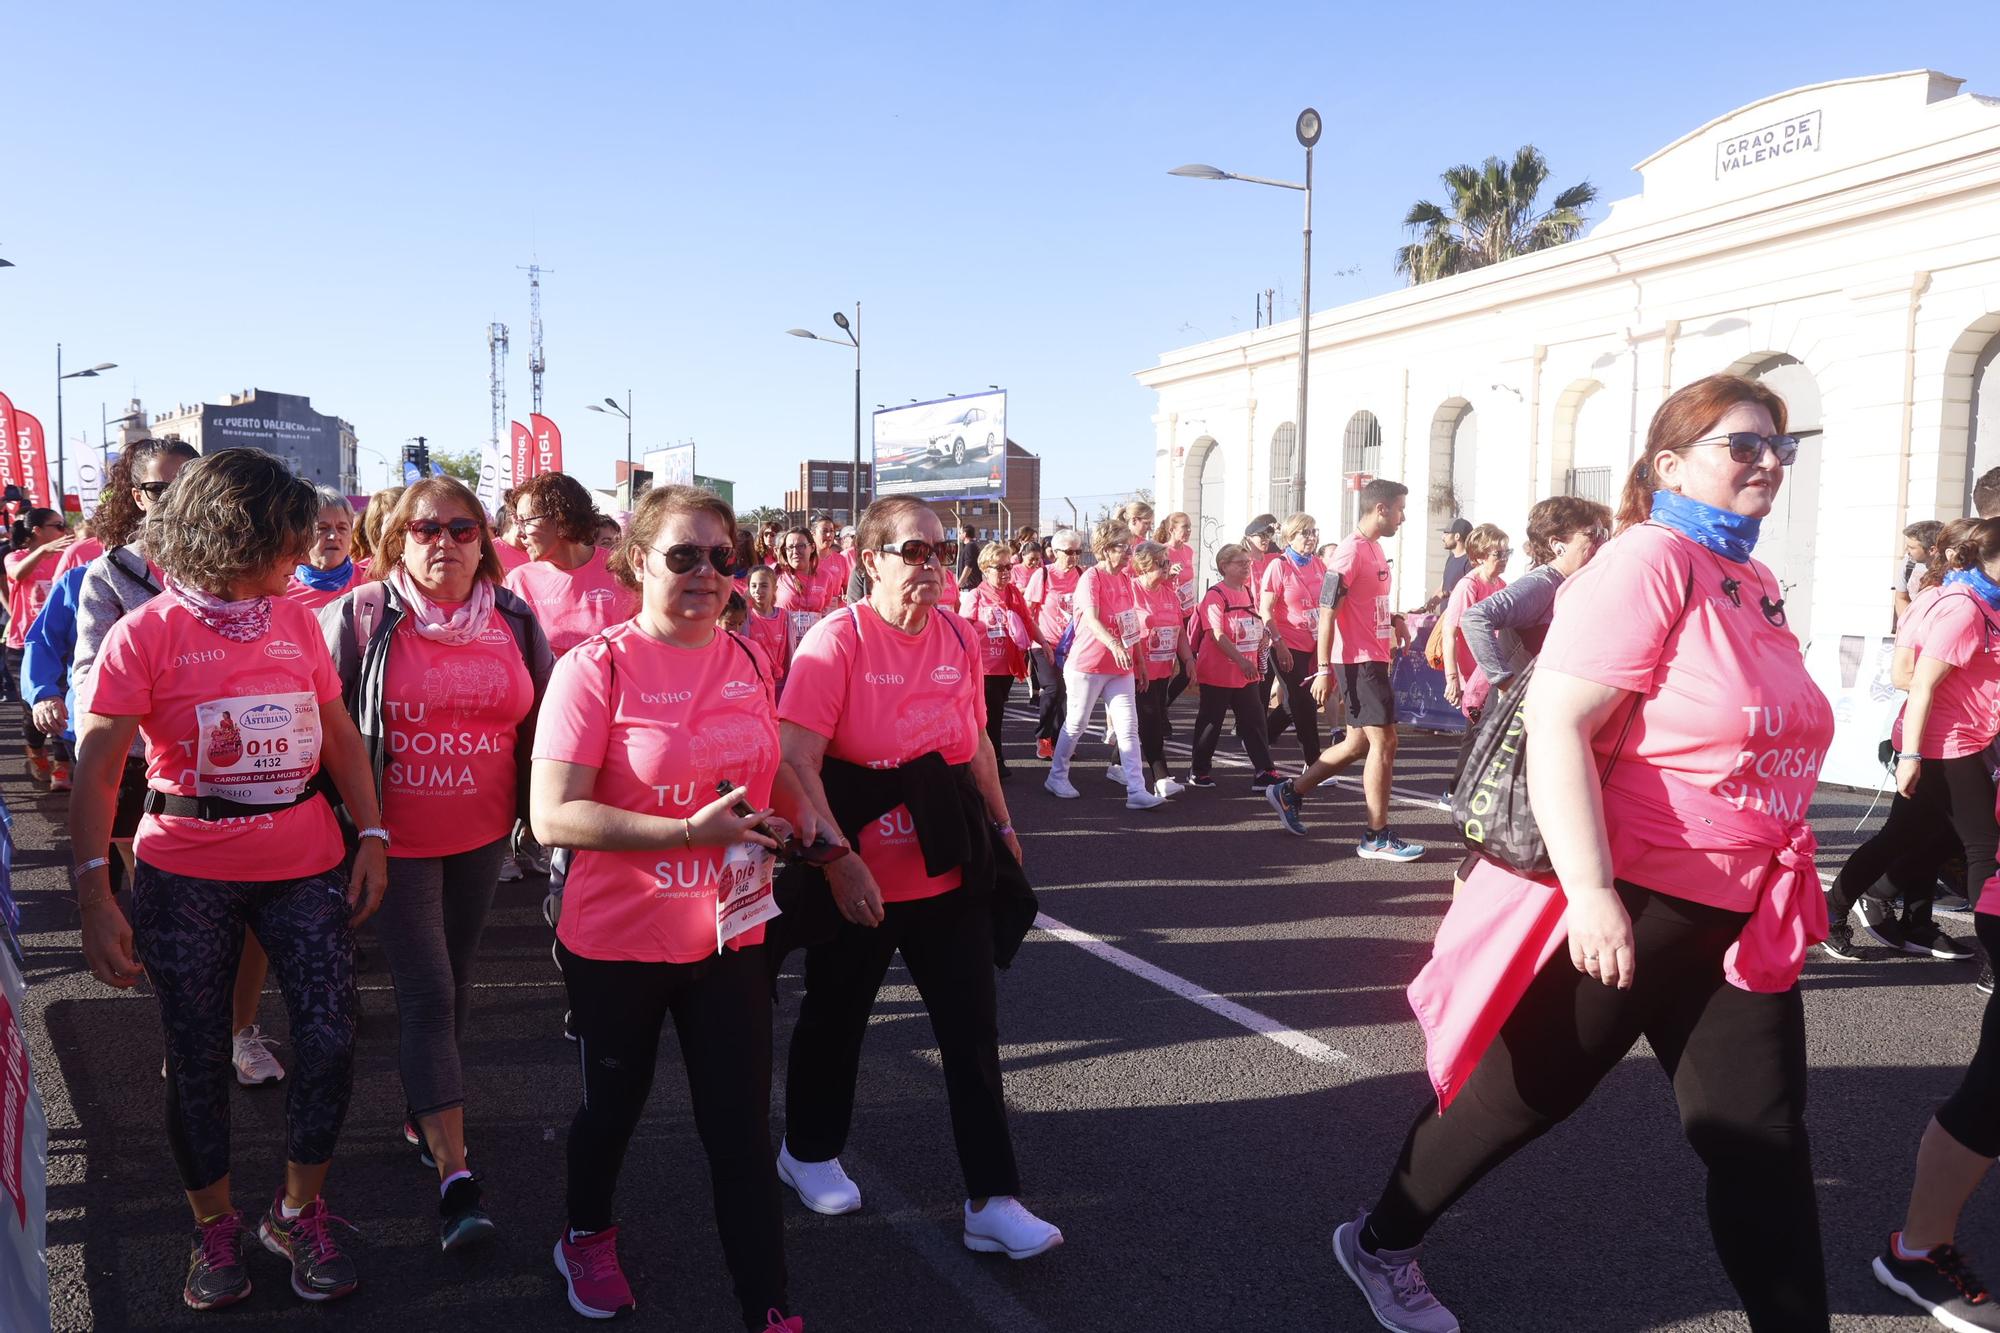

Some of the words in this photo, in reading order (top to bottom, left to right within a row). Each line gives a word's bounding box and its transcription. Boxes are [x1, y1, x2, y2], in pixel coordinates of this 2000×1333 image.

[1726, 131, 1774, 156] GRAO
[1785, 118, 1811, 139] DE
[1722, 134, 1813, 172] VALENCIA
[213, 418, 224, 426] EL
[225, 417, 261, 429] PUERTO
[173, 648, 226, 669] OYSHO
[864, 671, 905, 686] OYSHO
[640, 690, 692, 705] OYSHO
[244, 713, 289, 726] ASTURIANA
[386, 701, 426, 723] TU
[1741, 705, 1784, 737] TU
[246, 737, 289, 756] 016
[254, 757, 281, 769] 4132
[214, 775, 252, 783] CARRERA
[276, 771, 301, 779] MUJER
[389, 761, 476, 788] SUMA
[651, 781, 696, 807] TU
[880, 811, 914, 837] SU
[654, 857, 719, 890] SUM
[735, 861, 756, 885] 016
[689, 889, 701, 898] DE
